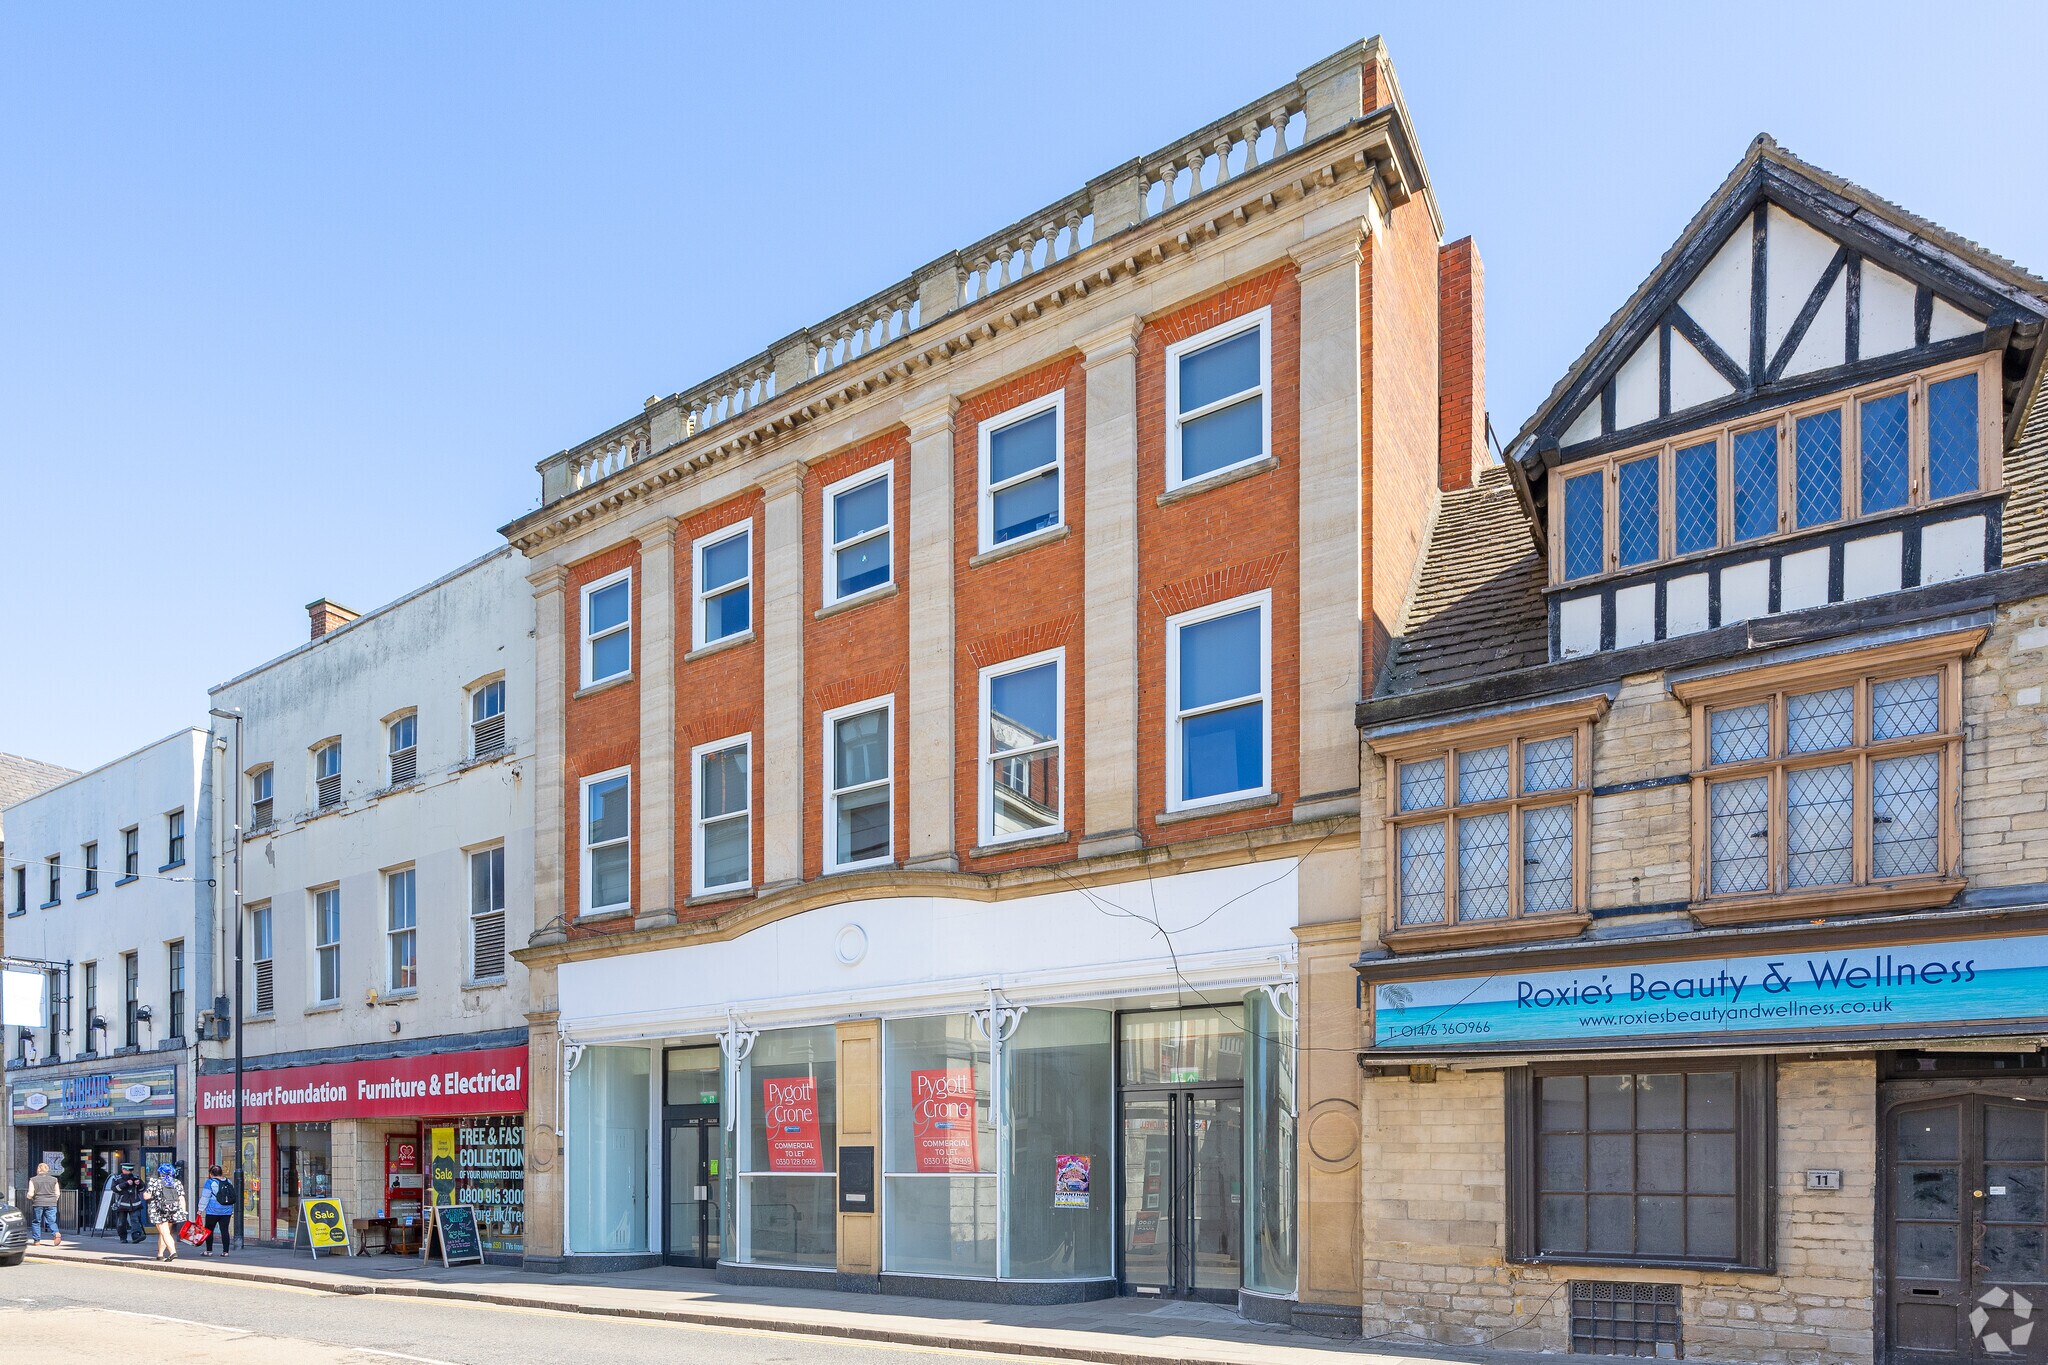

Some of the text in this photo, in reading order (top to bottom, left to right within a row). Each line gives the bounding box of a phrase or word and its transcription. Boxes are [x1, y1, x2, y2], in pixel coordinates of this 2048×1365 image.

[1517, 955, 1976, 1008] Roxie's Beauty & Wellness
[1579, 996, 1893, 1026] www.roxiesbeautyandwellness.co.uk
[1388, 1021, 1490, 1038] T: 01476 360966
[62, 1074, 111, 1109] KLUBHAUS
[358, 1066, 521, 1100] Furniture & Electrical
[918, 1074, 968, 1099] Pygott
[242, 1088, 273, 1107] Heart
[275, 1082, 347, 1105] Foundation
[769, 1083, 812, 1106] Pygott
[774, 1106, 813, 1122] Crone
[924, 1100, 969, 1118] Crone
[460, 1126, 524, 1146] FREE & FAST
[460, 1148, 524, 1167] COLLECTION
[435, 1168, 452, 1180] Sale
[460, 1171, 466, 1179] OF
[467, 1170, 480, 1179] YOUR
[481, 1170, 509, 1179] UNWANTED
[1815, 1175, 1827, 1185] 11
[460, 1188, 483, 1204] 0800
[486, 1188, 500, 1204] 915
[315, 1211, 335, 1219] Sale
